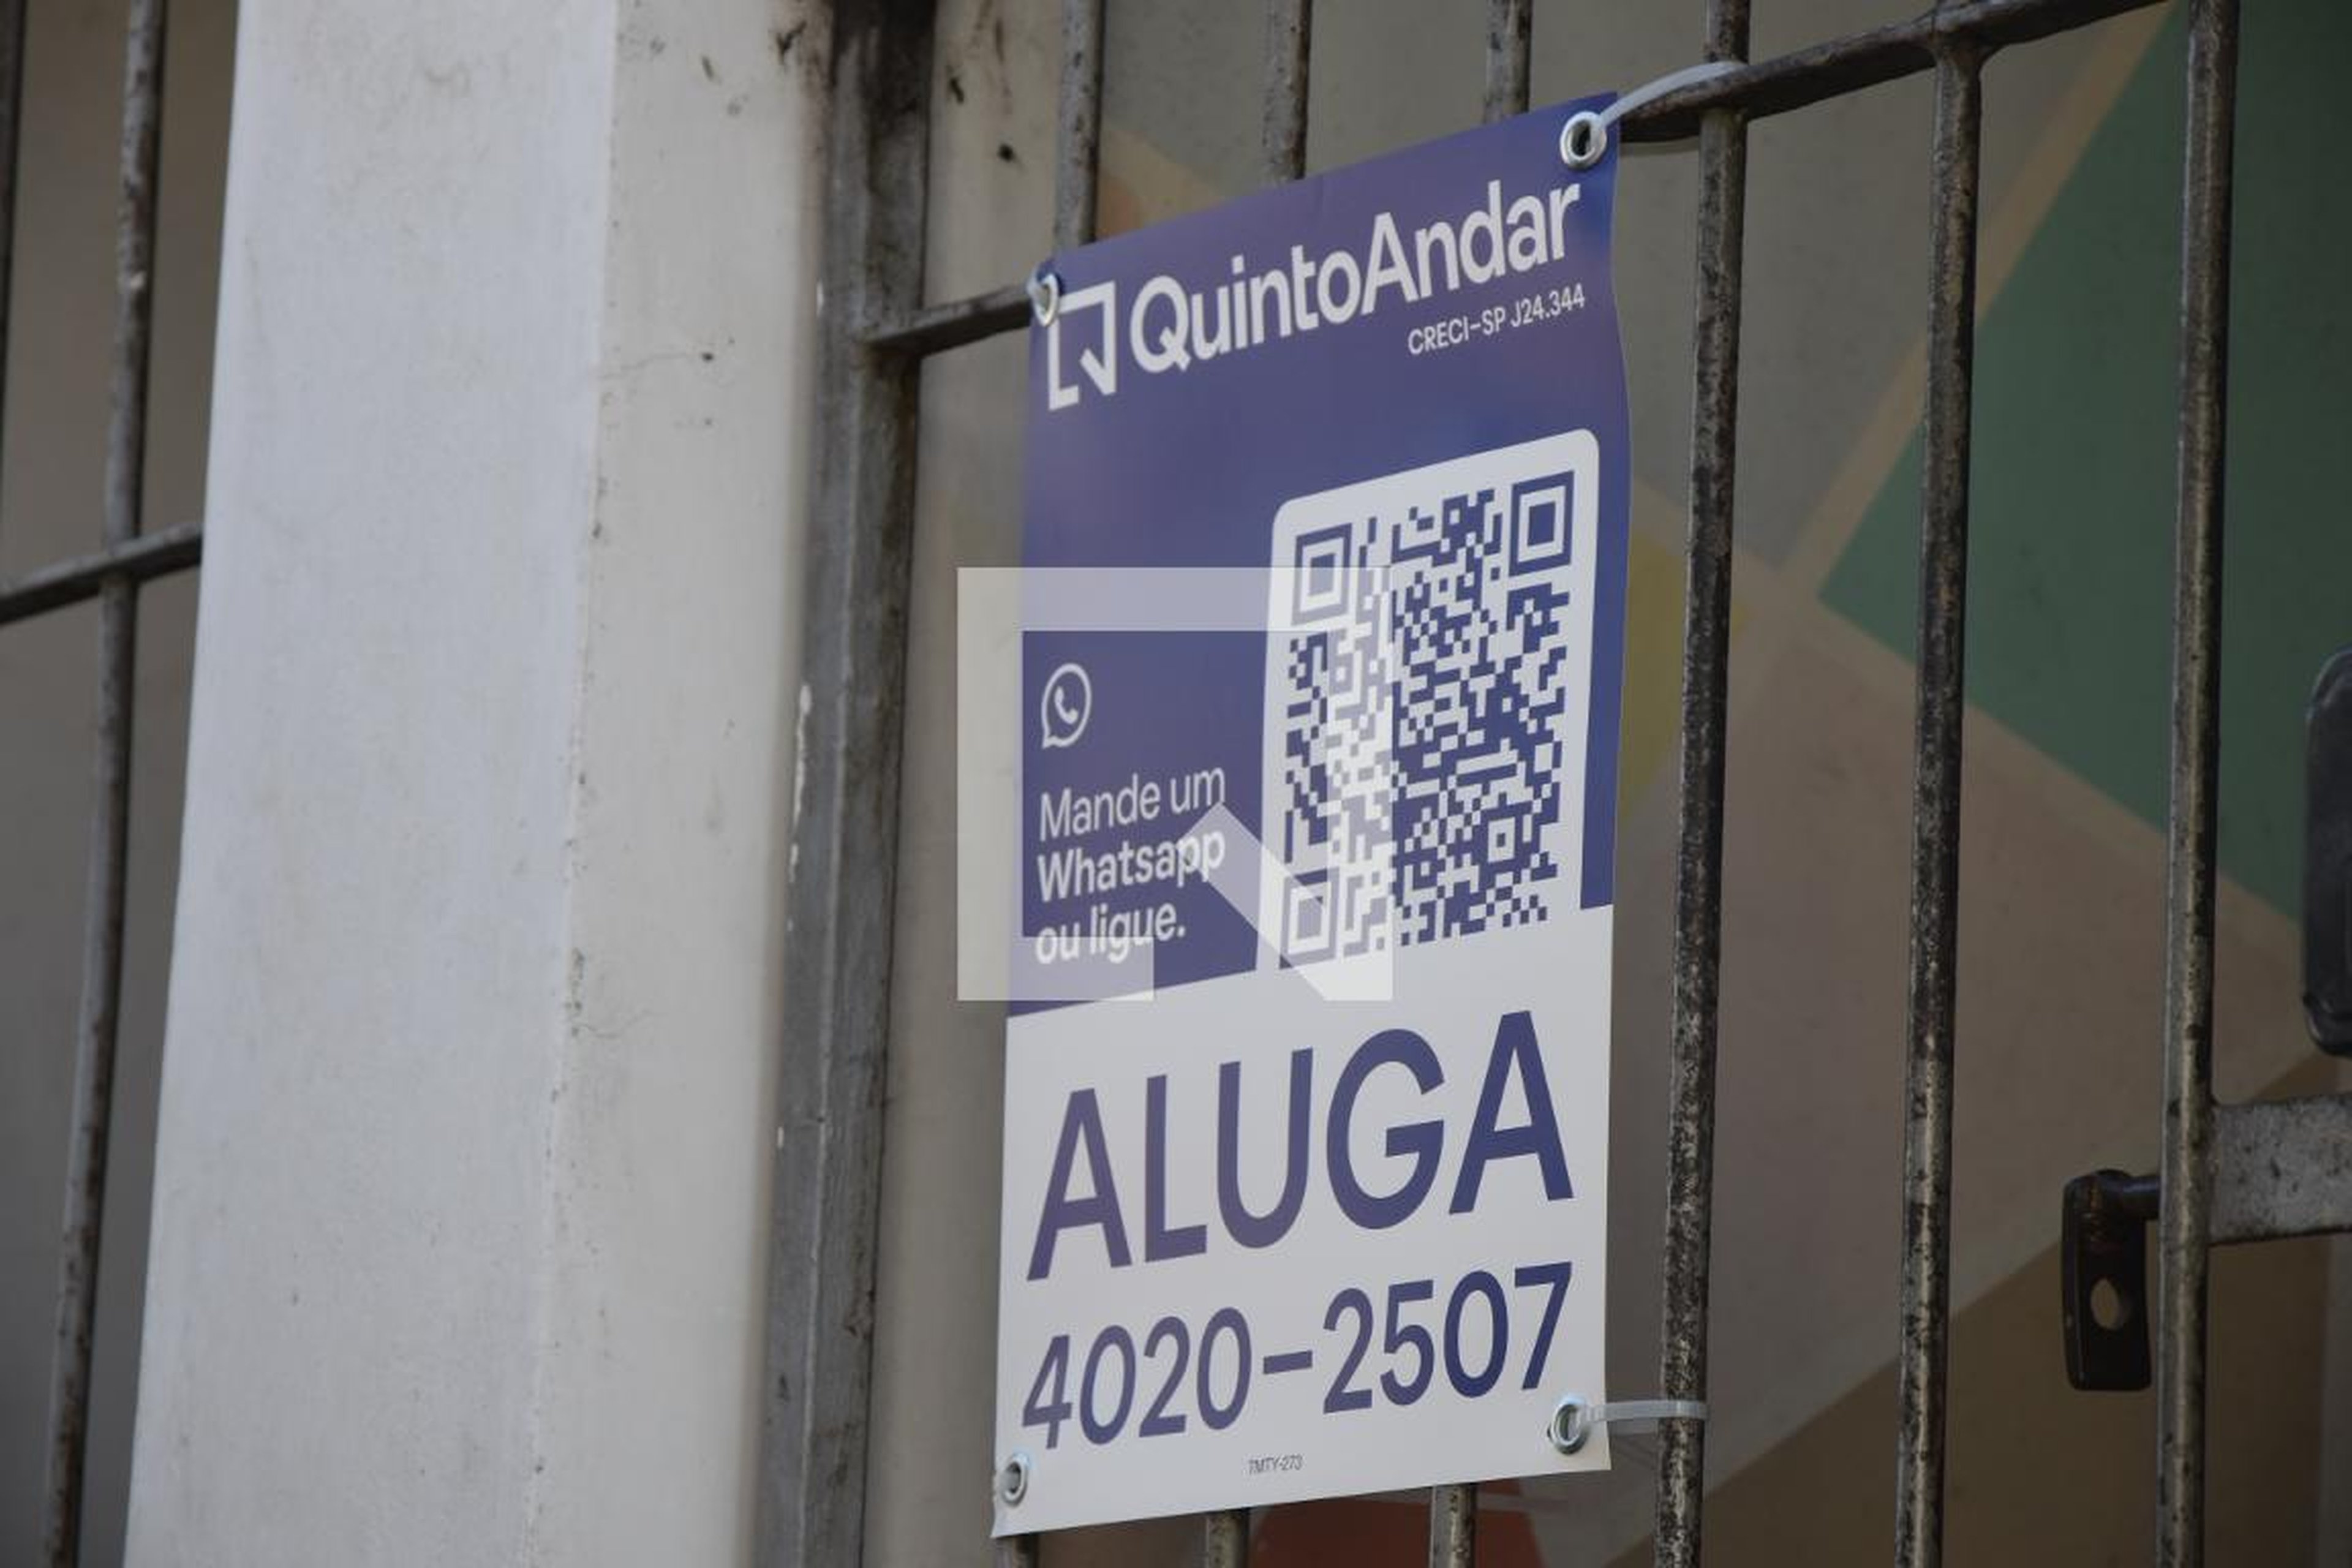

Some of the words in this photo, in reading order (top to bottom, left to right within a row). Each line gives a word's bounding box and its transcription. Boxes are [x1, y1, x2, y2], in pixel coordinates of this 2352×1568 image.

[1130, 179, 1580, 372] QuintoAndar
[1510, 283, 1586, 328] J24.344
[1039, 773, 1160, 842] Mande
[1170, 767, 1226, 813] um
[1038, 830, 1226, 902] Whatsapp
[1035, 921, 1079, 964] ou
[1090, 903, 1186, 964] ligue.
[1026, 1010, 1574, 1281] ALUGA
[1022, 1262, 1573, 1450] 4020-2507
